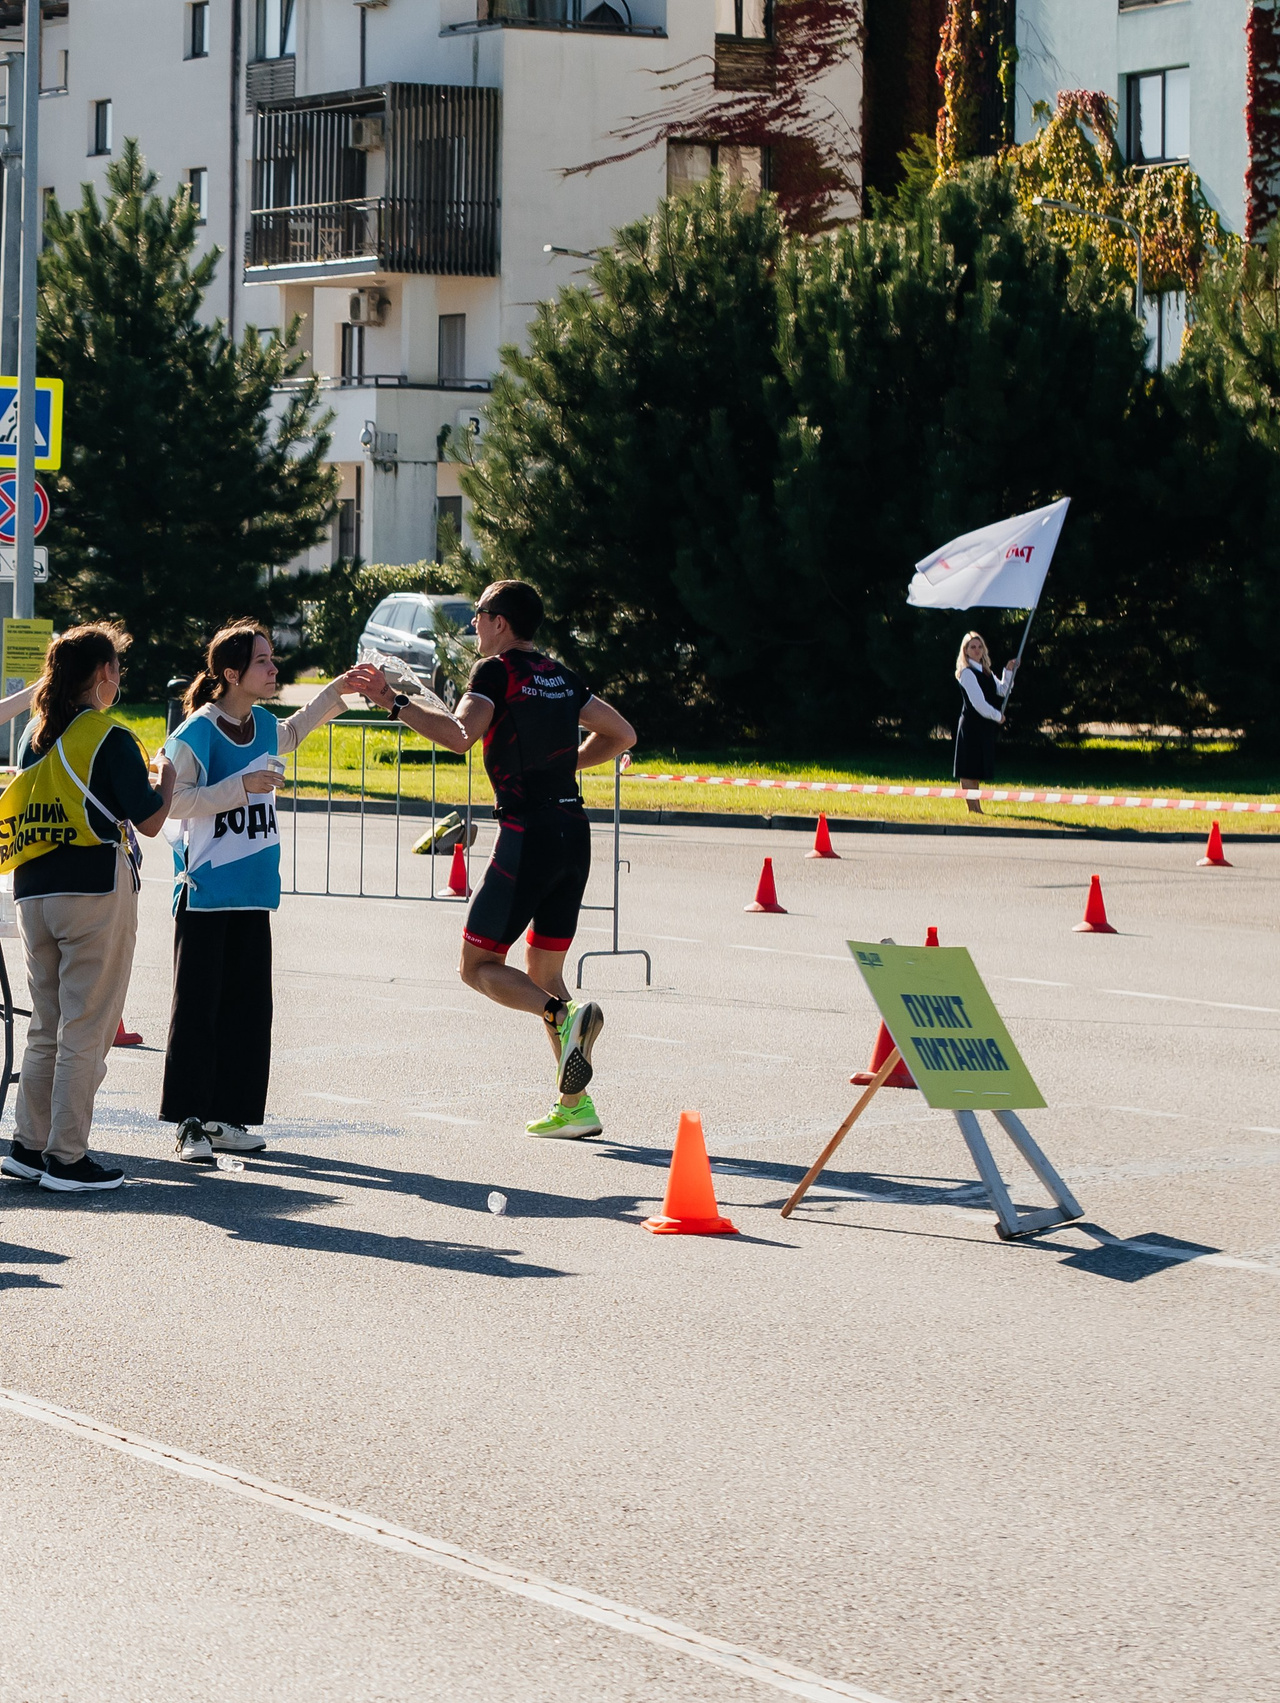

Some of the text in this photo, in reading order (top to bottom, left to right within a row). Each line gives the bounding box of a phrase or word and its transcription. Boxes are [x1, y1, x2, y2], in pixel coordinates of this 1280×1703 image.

[521, 685, 538, 696] RZD
[533, 674, 566, 688] KHARIN
[212, 803, 278, 840] ВОДА
[465, 932, 482, 943] Team
[900, 994, 973, 1029] ПУНКТ
[910, 1037, 1010, 1071] ПИТАНИЯ
